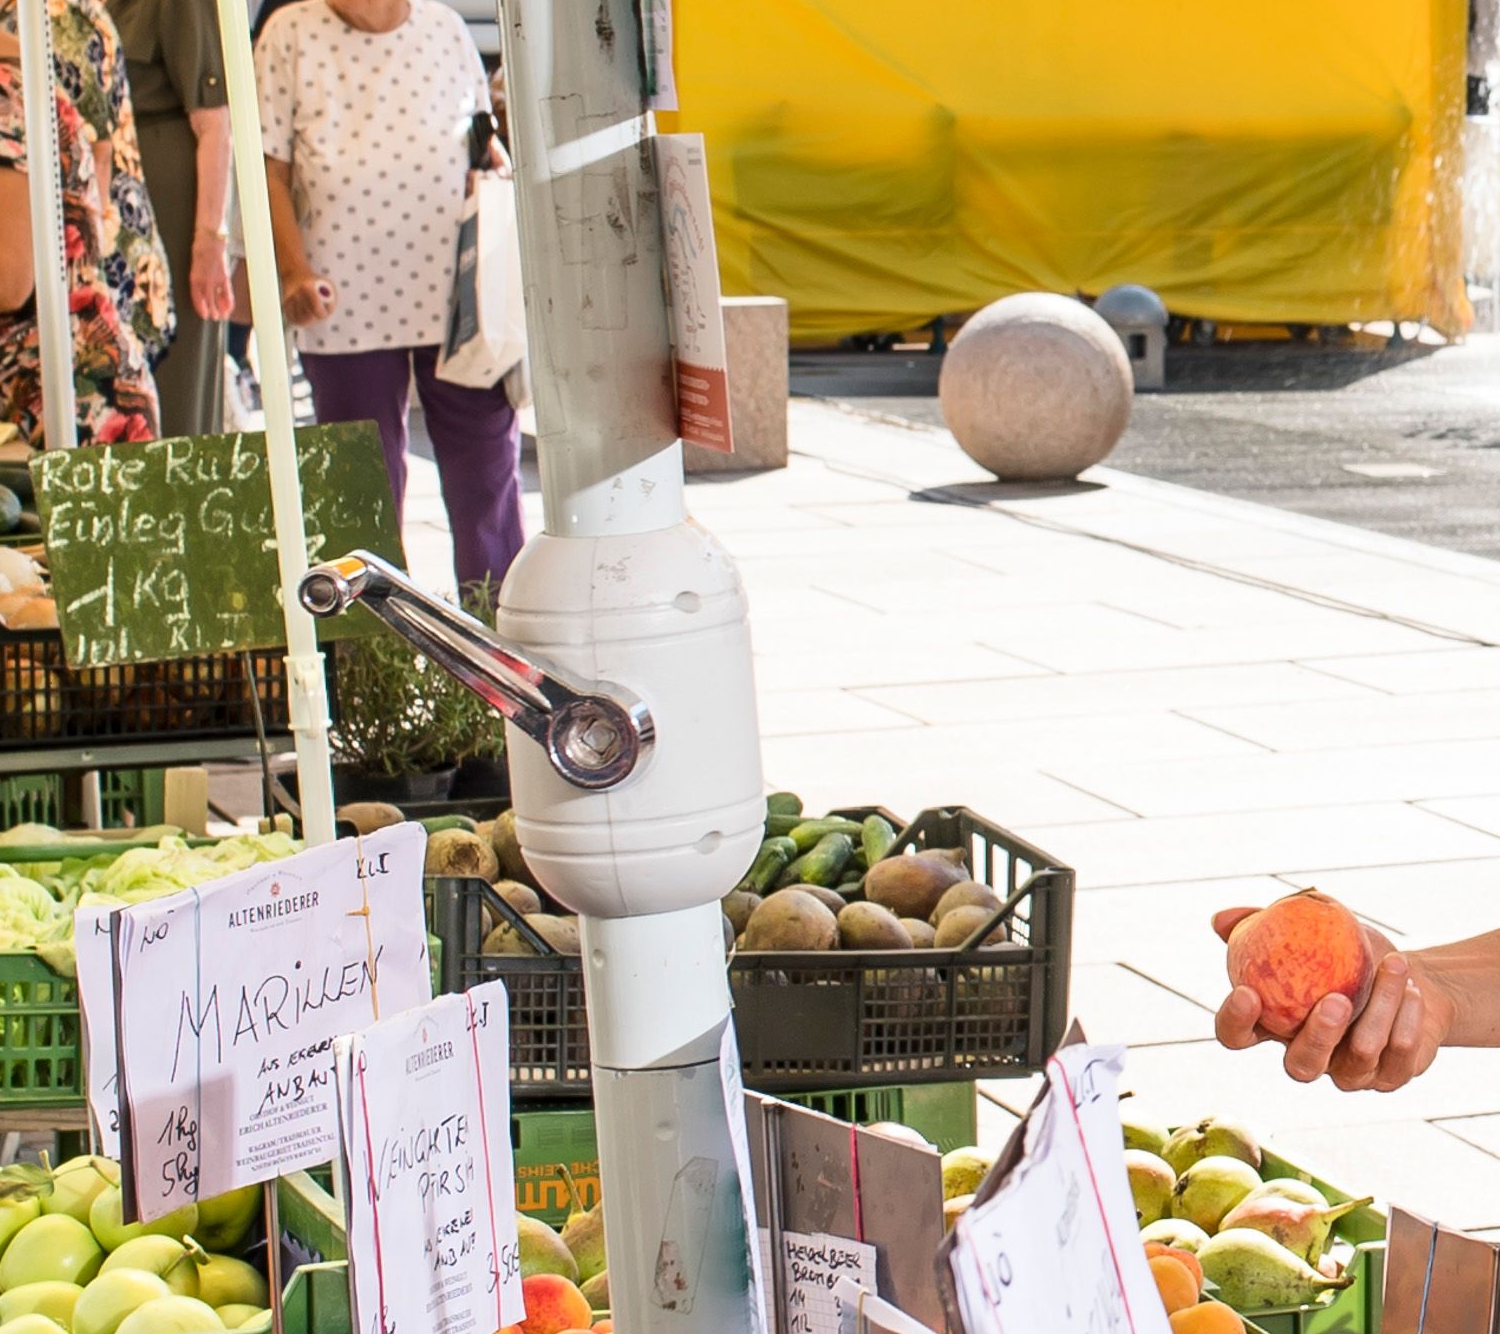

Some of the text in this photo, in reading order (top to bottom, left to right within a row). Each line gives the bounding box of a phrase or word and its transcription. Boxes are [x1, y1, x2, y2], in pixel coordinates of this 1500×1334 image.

[29, 432, 332, 495] Rote Rübn
[228, 890, 320, 930] ALTENRIEDERER
